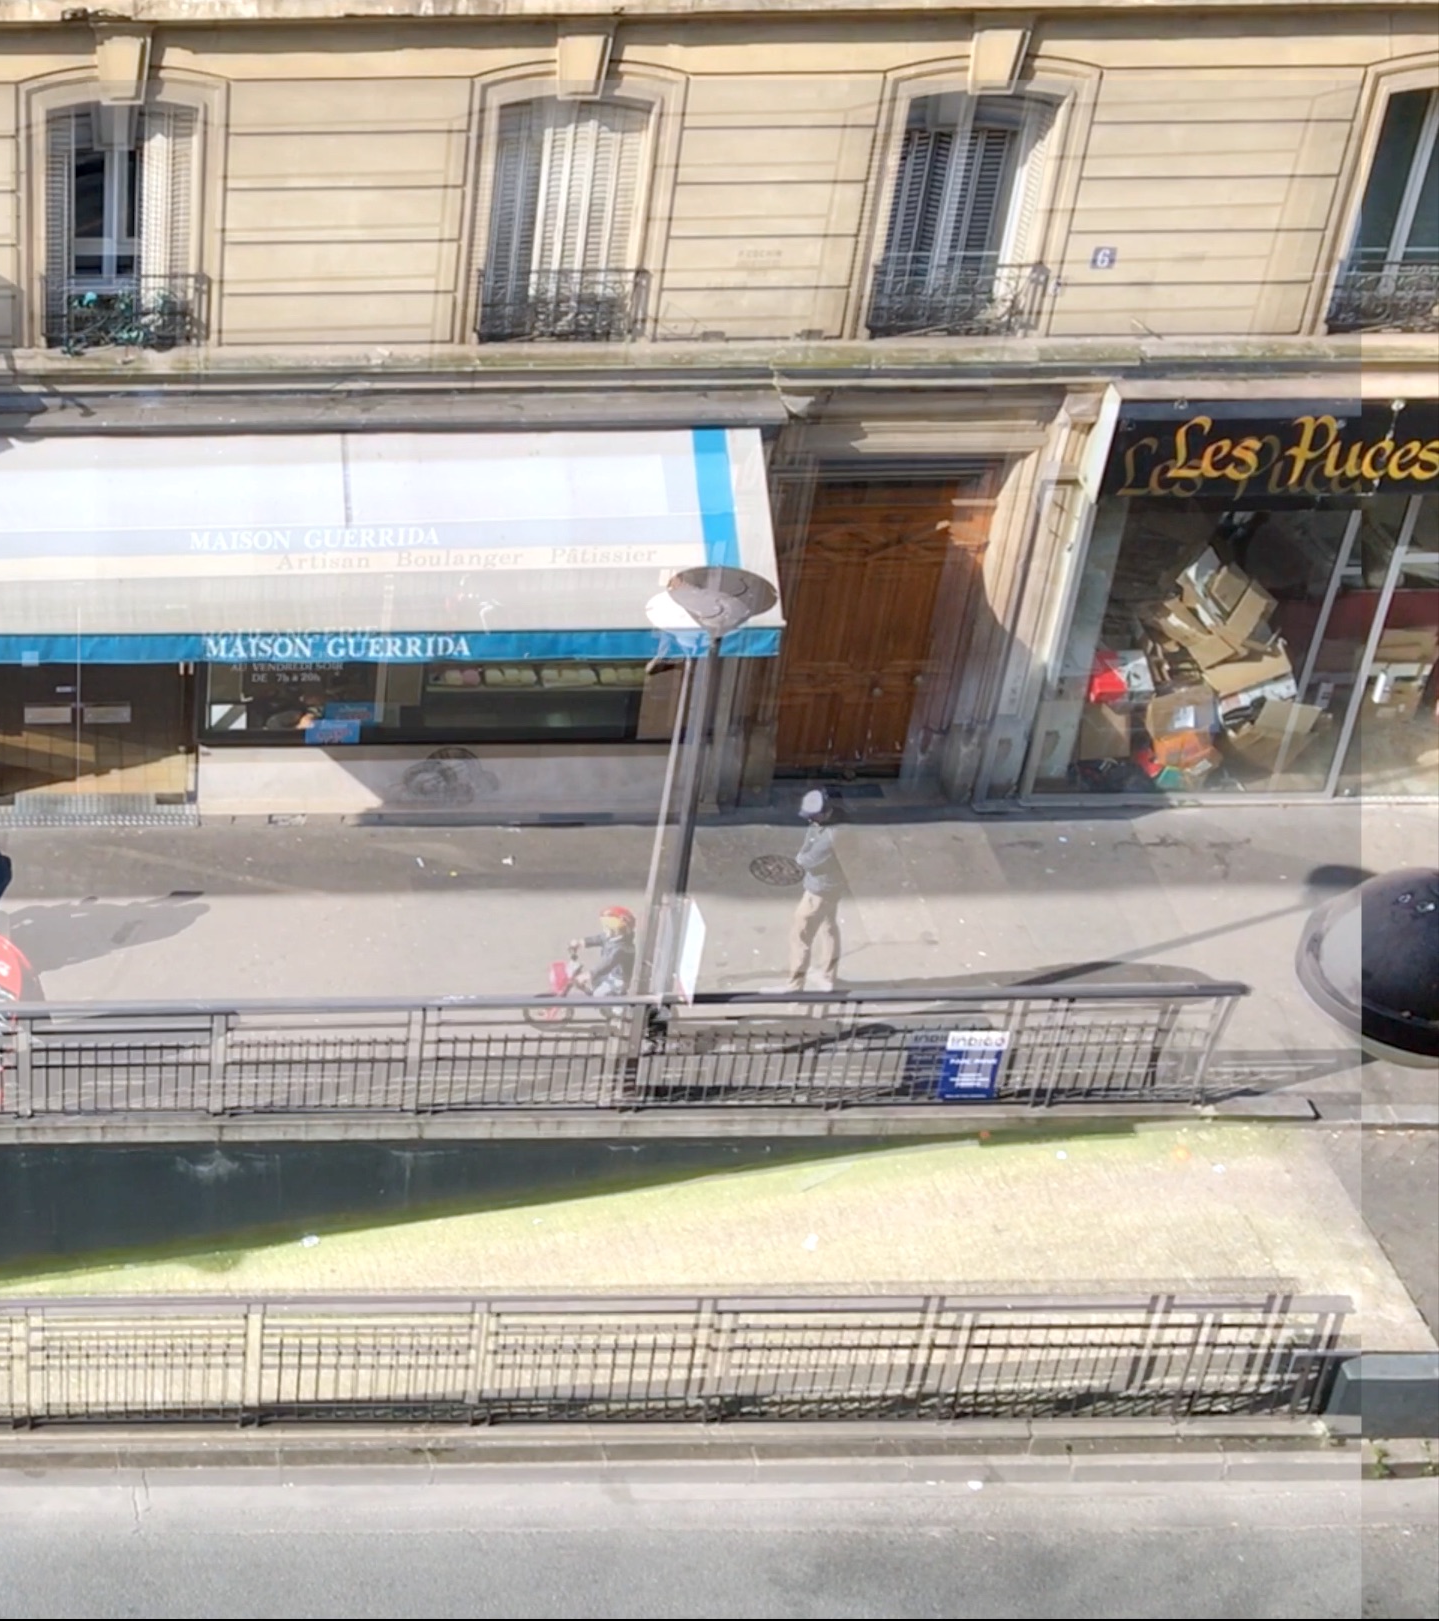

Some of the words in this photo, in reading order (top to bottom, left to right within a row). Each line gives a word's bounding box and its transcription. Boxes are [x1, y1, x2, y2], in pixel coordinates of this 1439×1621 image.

[1096, 248, 1111, 268] 6
[1167, 415, 1262, 481] Les
[1284, 414, 1439, 486] Puces
[190, 530, 292, 550] MAISON
[303, 526, 440, 549] GUERRIDA
[275, 553, 371, 571] Artisan
[397, 550, 523, 570] Boulanger
[548, 547, 658, 565] Pâtissier
[205, 636, 313, 658] MAISON
[326, 635, 471, 658] GUERRIDA
